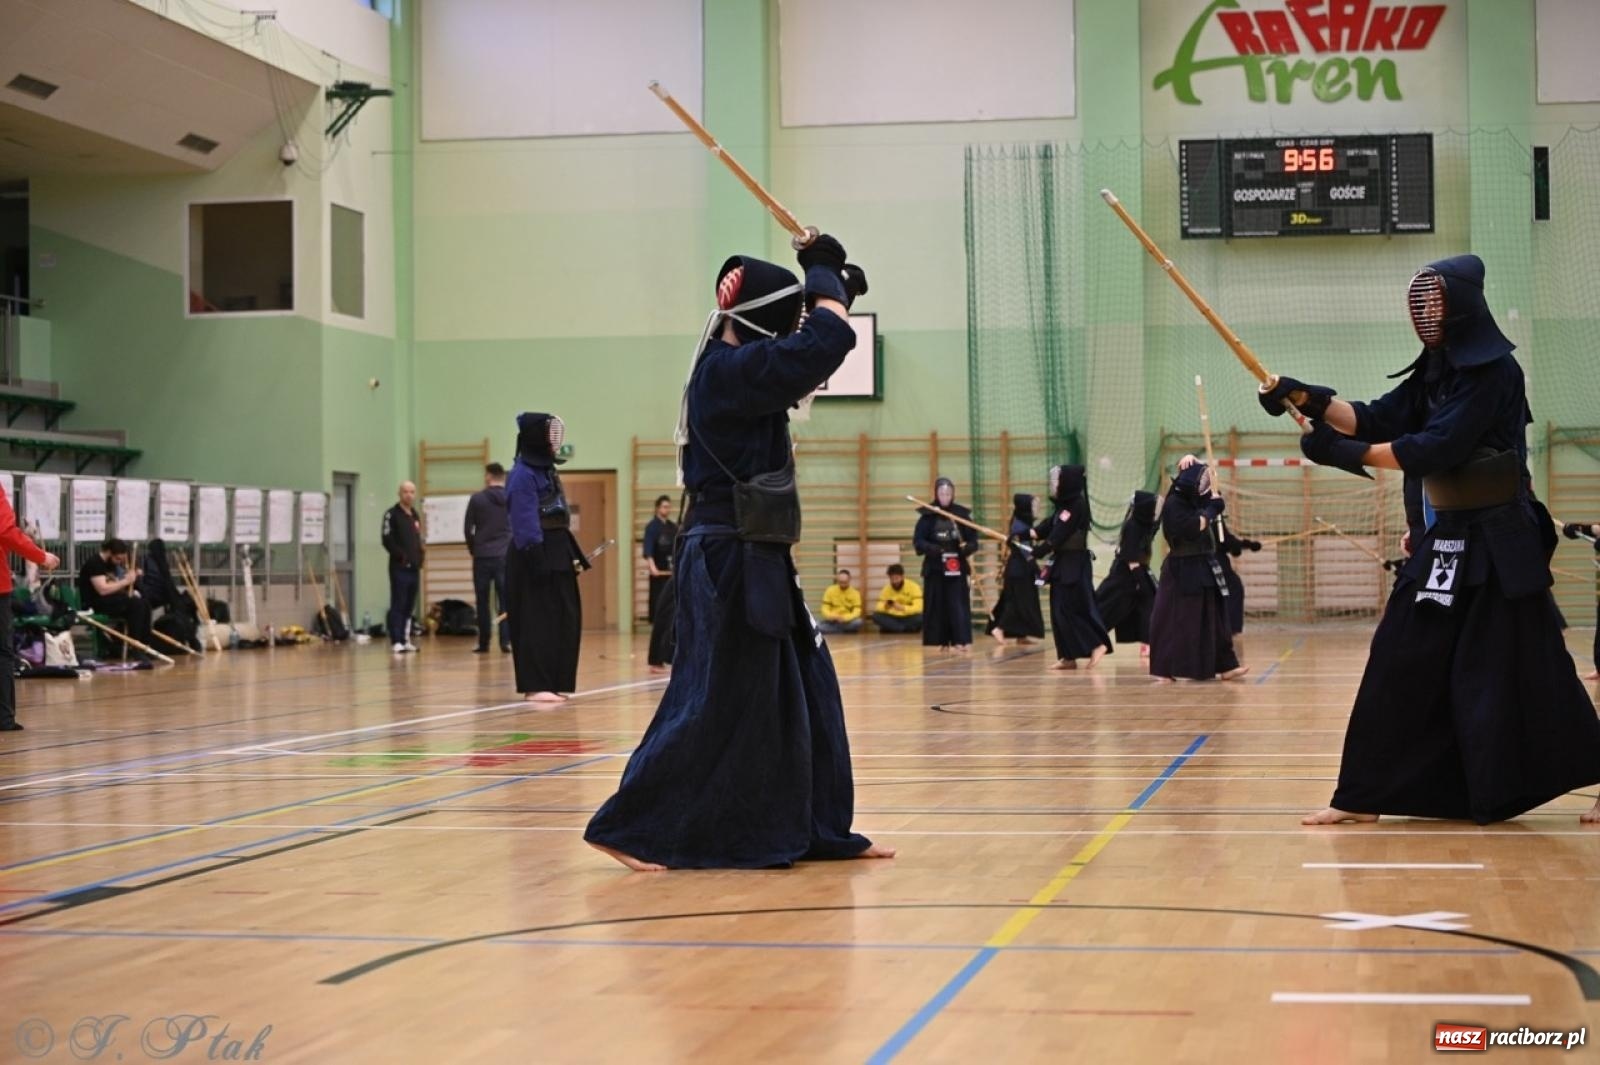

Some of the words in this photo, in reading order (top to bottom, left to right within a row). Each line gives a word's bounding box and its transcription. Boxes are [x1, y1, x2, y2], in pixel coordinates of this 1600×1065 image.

[1216, 0, 1446, 54] RAFAKO
[1283, 149, 1334, 171] 9:56
[1233, 187, 1296, 202] GOSPODARZE
[1329, 184, 1365, 200] GOŚCIE
